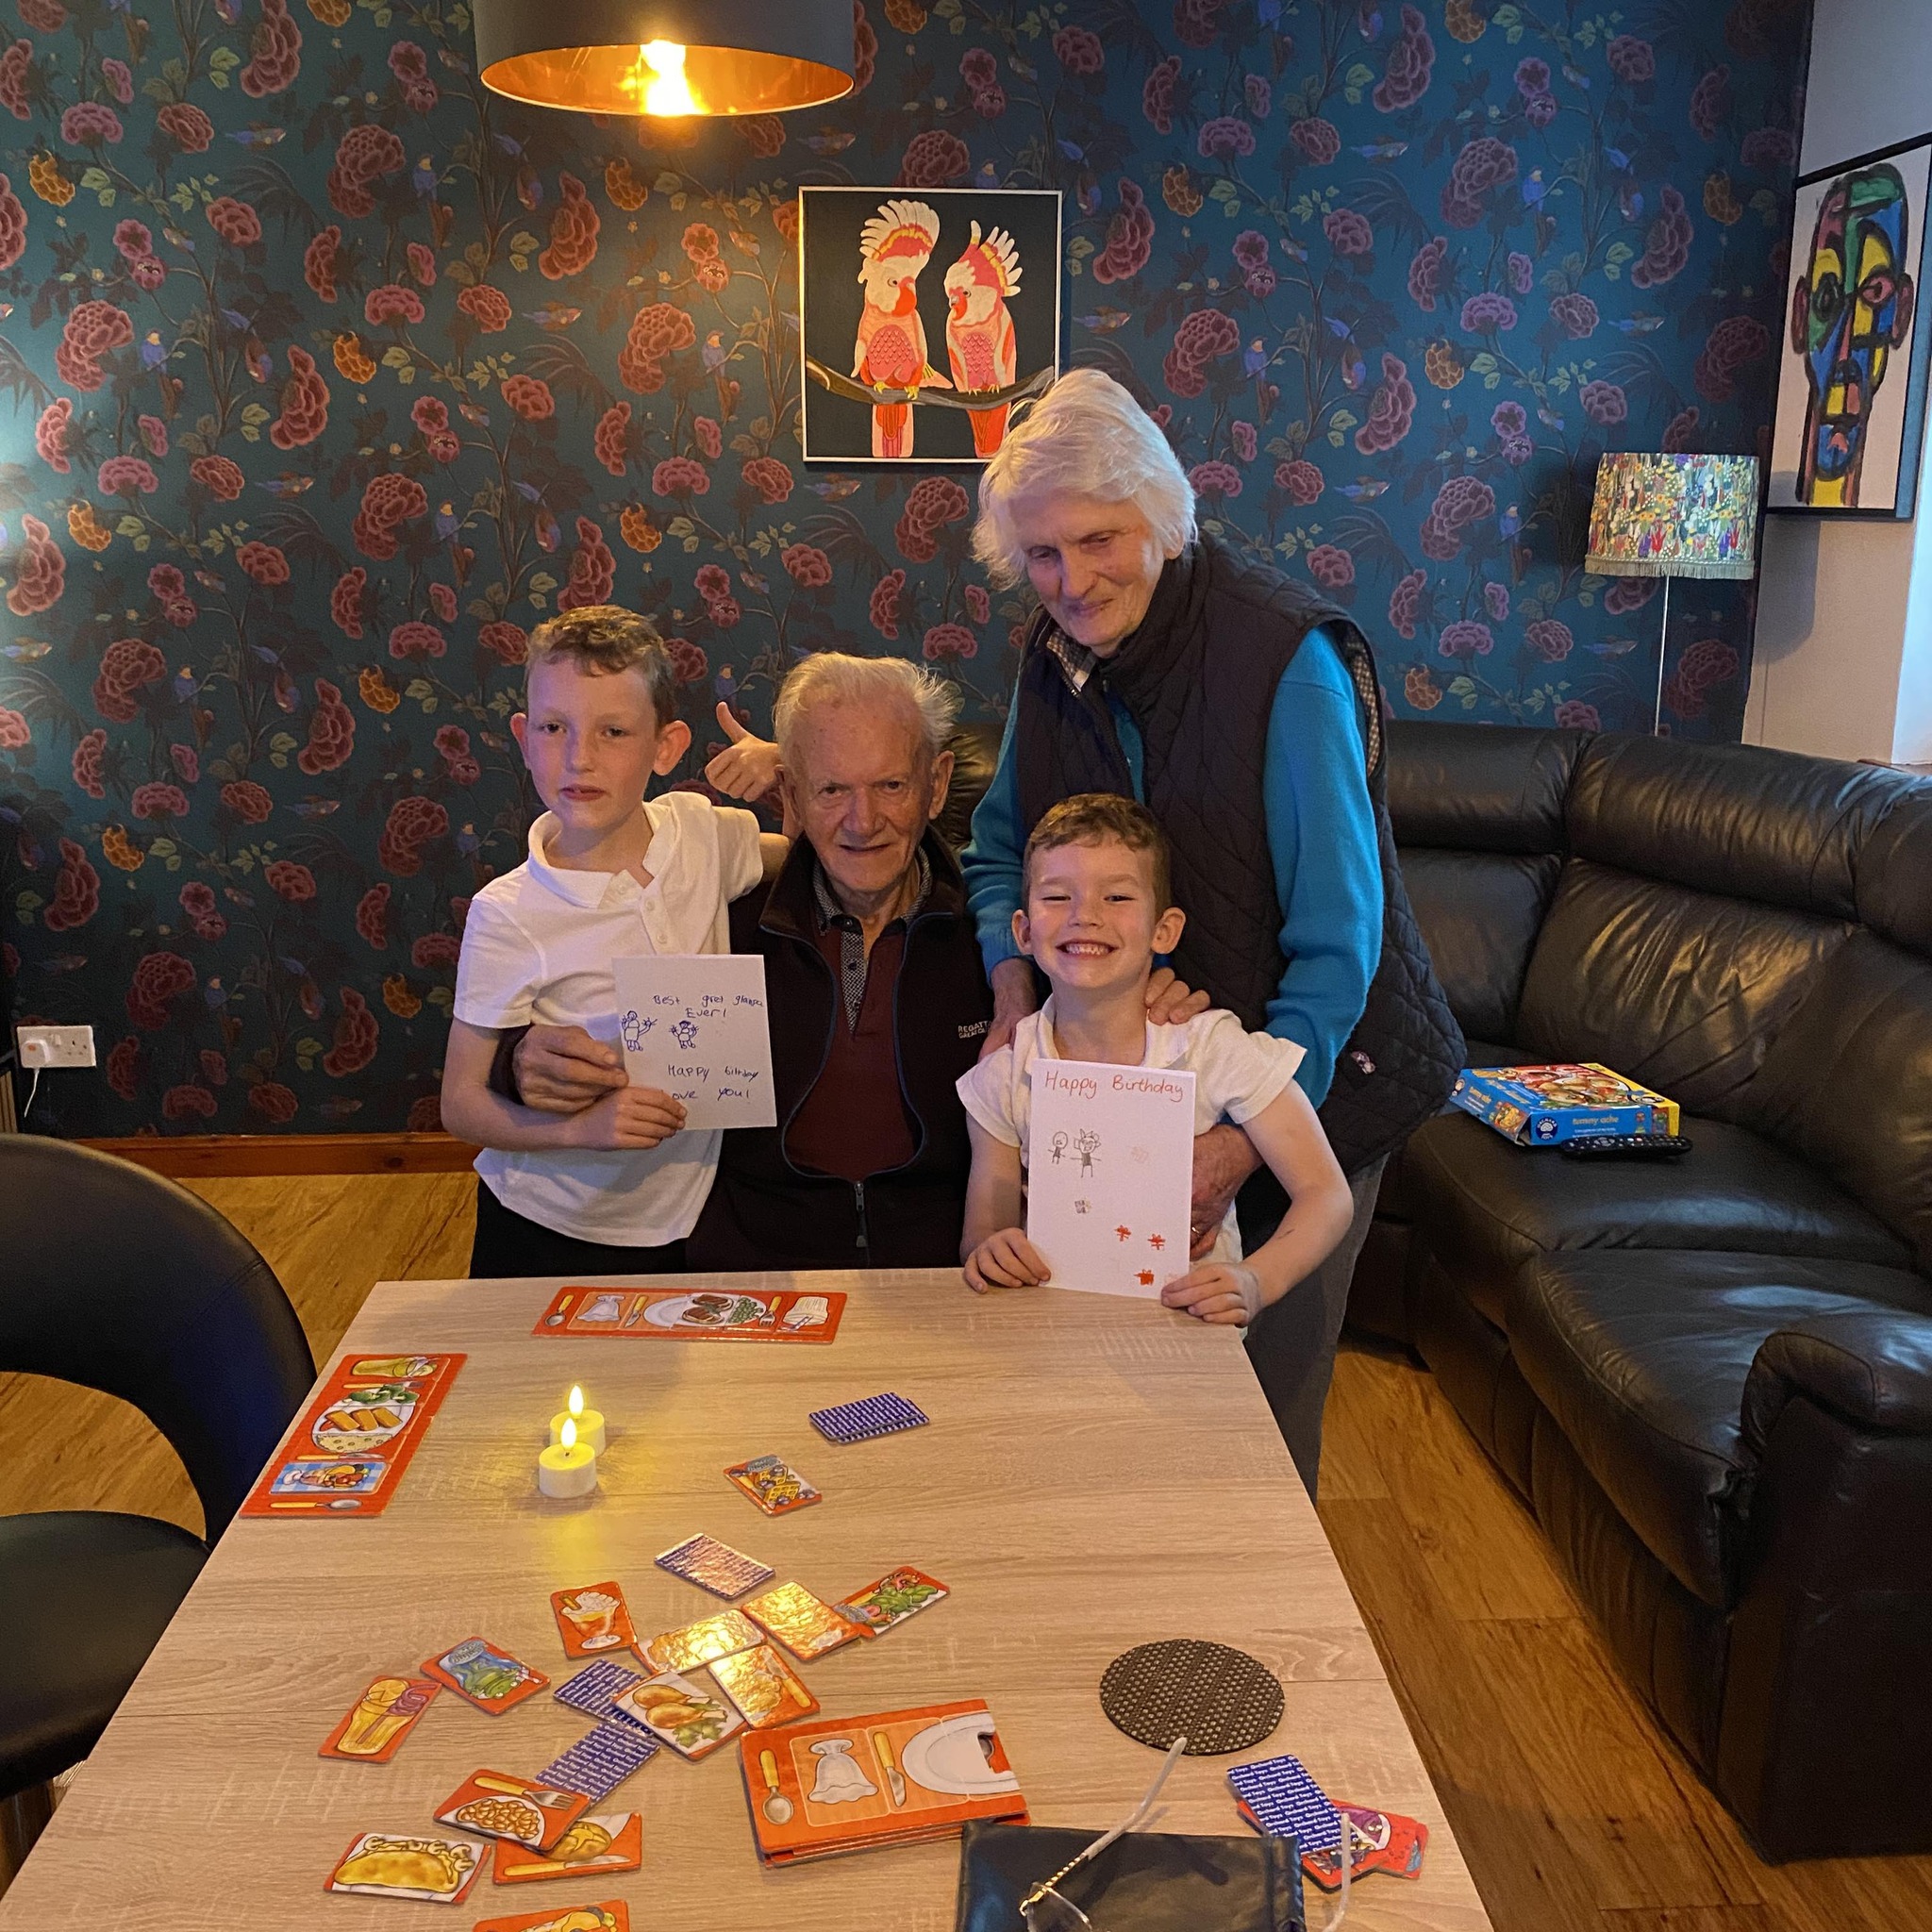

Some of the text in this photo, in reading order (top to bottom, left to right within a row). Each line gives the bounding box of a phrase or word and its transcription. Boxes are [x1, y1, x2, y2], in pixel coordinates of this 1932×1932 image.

[668, 1064, 709, 1083] Happy
[1044, 1071, 1183, 1103] Happy Birthday
